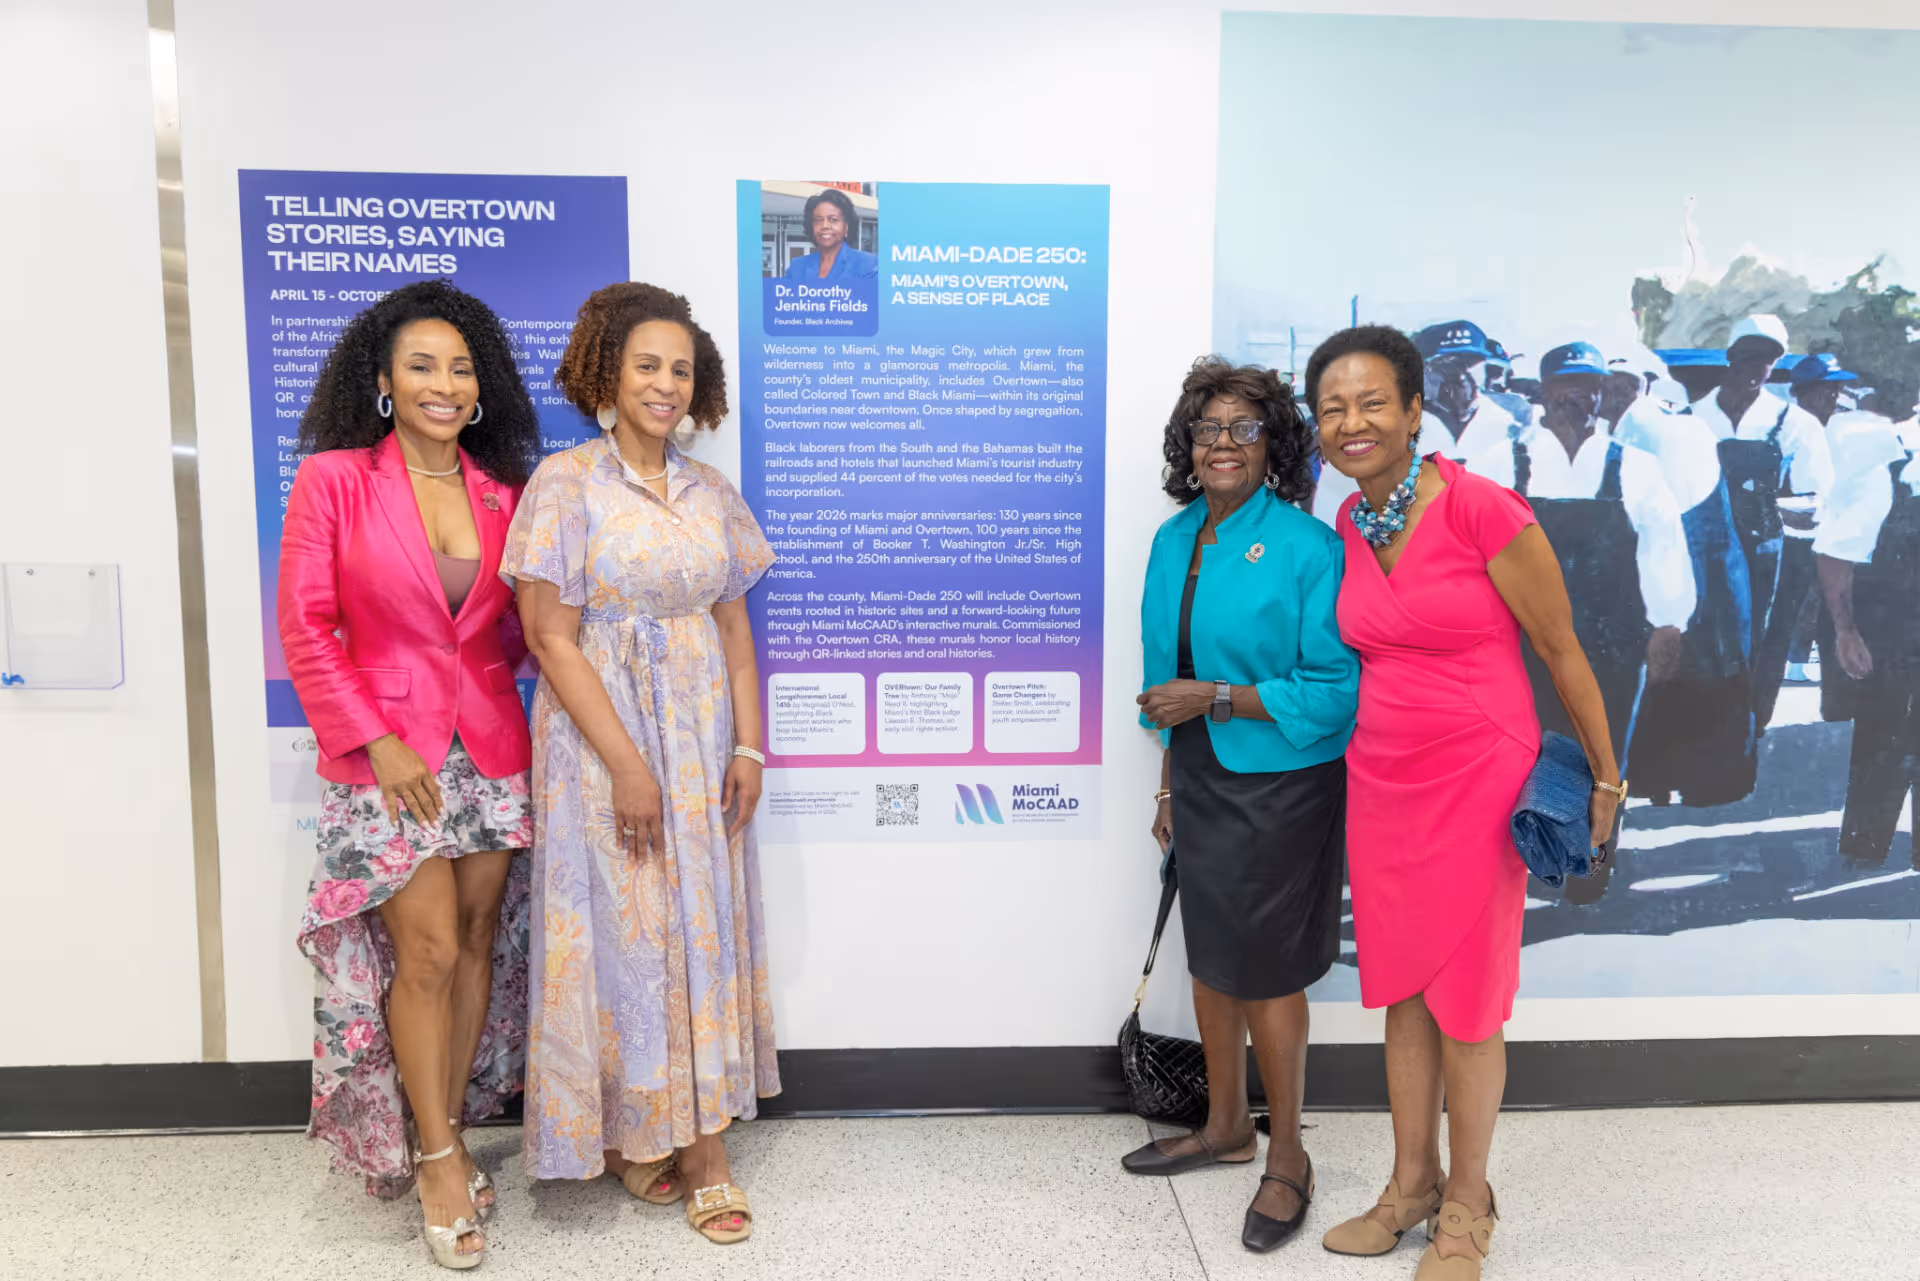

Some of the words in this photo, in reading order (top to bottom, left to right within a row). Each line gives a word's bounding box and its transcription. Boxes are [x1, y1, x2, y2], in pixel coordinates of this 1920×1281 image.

[264, 196, 384, 217] TELLING
[388, 199, 555, 220] OVERTOWN
[266, 223, 394, 247] STORIES,
[397, 226, 505, 247] SAYING
[891, 245, 1033, 263] MIAMI-DADE
[1036, 246, 1087, 264] 250:
[267, 251, 351, 272] THEIR
[354, 253, 458, 273] NAMES
[891, 274, 959, 288] MIAMI'S
[962, 275, 1069, 291] OVERTOWN,
[270, 289, 309, 301] APRIL
[311, 289, 326, 301] 15
[775, 284, 794, 297] Dr.
[798, 284, 852, 300] Dorothy
[890, 291, 906, 305] A
[907, 292, 964, 305] SENSE
[966, 292, 989, 306] OF
[992, 292, 1050, 306] PLACE
[774, 299, 826, 312] Jenkins
[829, 299, 868, 312] Fields
[272, 315, 282, 326] In
[286, 316, 352, 328] partnershi
[272, 331, 284, 342] of
[288, 331, 307, 342] the
[311, 332, 339, 342] Afric
[525, 334, 545, 344] this
[763, 343, 817, 355] Welcome
[824, 345, 836, 355] to
[842, 344, 880, 356] Miami,
[886, 344, 905, 355] the
[911, 344, 946, 358] Magic
[951, 344, 976, 358] City,
[983, 345, 1017, 356] which
[1023, 348, 1052, 359] grew
[1057, 345, 1084, 356] from
[273, 362, 317, 372] cultural
[518, 364, 544, 374] urals
[529, 380, 550, 389] oral
[763, 374, 812, 387] county's
[818, 374, 854, 385] oldest
[861, 374, 931, 388] municipality,
[938, 375, 986, 386] includes
[275, 392, 294, 402] QR
[764, 388, 798, 400] called
[801, 388, 847, 400] Colored
[850, 389, 880, 400] Town
[883, 390, 905, 400] and
[908, 389, 939, 400] Black
[1026, 390, 1039, 401] its
[1042, 390, 1084, 403] original
[764, 403, 828, 415] boundaries
[830, 406, 856, 415] near
[922, 404, 953, 415] Once
[955, 404, 996, 418] shaped
[998, 405, 1012, 418] by
[764, 418, 820, 430] Overtown
[823, 421, 848, 430] now
[850, 419, 906, 430] welcomes
[908, 419, 925, 430] all.
[543, 438, 576, 448] Local
[765, 442, 796, 453] Black
[799, 442, 846, 453] laborers
[848, 442, 876, 453] from
[879, 442, 898, 453] the
[900, 442, 933, 453] South
[936, 442, 958, 453] and
[962, 442, 980, 454] the
[983, 442, 1034, 453] Bahamas
[1037, 443, 1062, 454] built
[1065, 443, 1083, 454] the
[765, 457, 814, 468] railroads
[816, 457, 838, 468] and
[841, 457, 874, 468] hotels
[877, 457, 899, 468] that
[902, 457, 954, 468] launched
[956, 457, 998, 468] Miami's
[1000, 458, 1035, 468] tourist
[1038, 458, 1083, 471] industry
[765, 486, 844, 500] incorporation.
[765, 509, 787, 520] The
[789, 512, 814, 523] year
[816, 509, 847, 520] 2026
[849, 509, 884, 520] marks
[886, 510, 918, 522] major
[920, 510, 996, 520] anniversaries:
[999, 509, 1019, 520] 130
[1021, 512, 1051, 523] years
[1053, 510, 1082, 521] since
[852, 539, 864, 550] of
[873, 538, 912, 550] Booker
[940, 539, 1006, 551] Washington
[1014, 538, 1046, 549] Jr./Sr.
[1056, 539, 1082, 554] High
[766, 568, 816, 579] America.
[766, 591, 803, 602] Across
[806, 591, 824, 602] the
[828, 592, 867, 604] county,
[870, 590, 936, 601] Miami-Dade
[940, 590, 962, 601] 250
[966, 590, 984, 601] will
[987, 590, 1026, 601] include
[1029, 590, 1081, 601] Overtown
[767, 620, 810, 633] through
[812, 620, 844, 630] Miami
[846, 619, 904, 630] MoCAAD's
[906, 620, 960, 630] interactive
[962, 619, 1000, 630] murals.
[1002, 619, 1081, 630] Commissioned
[768, 649, 810, 662] through
[812, 648, 866, 659] QR-linked
[867, 648, 902, 659] stories
[904, 648, 925, 659] and
[926, 648, 947, 658] oral
[948, 648, 995, 658] histories.
[1012, 783, 1060, 797] Miami
[1012, 798, 1079, 810] MoCAAD
